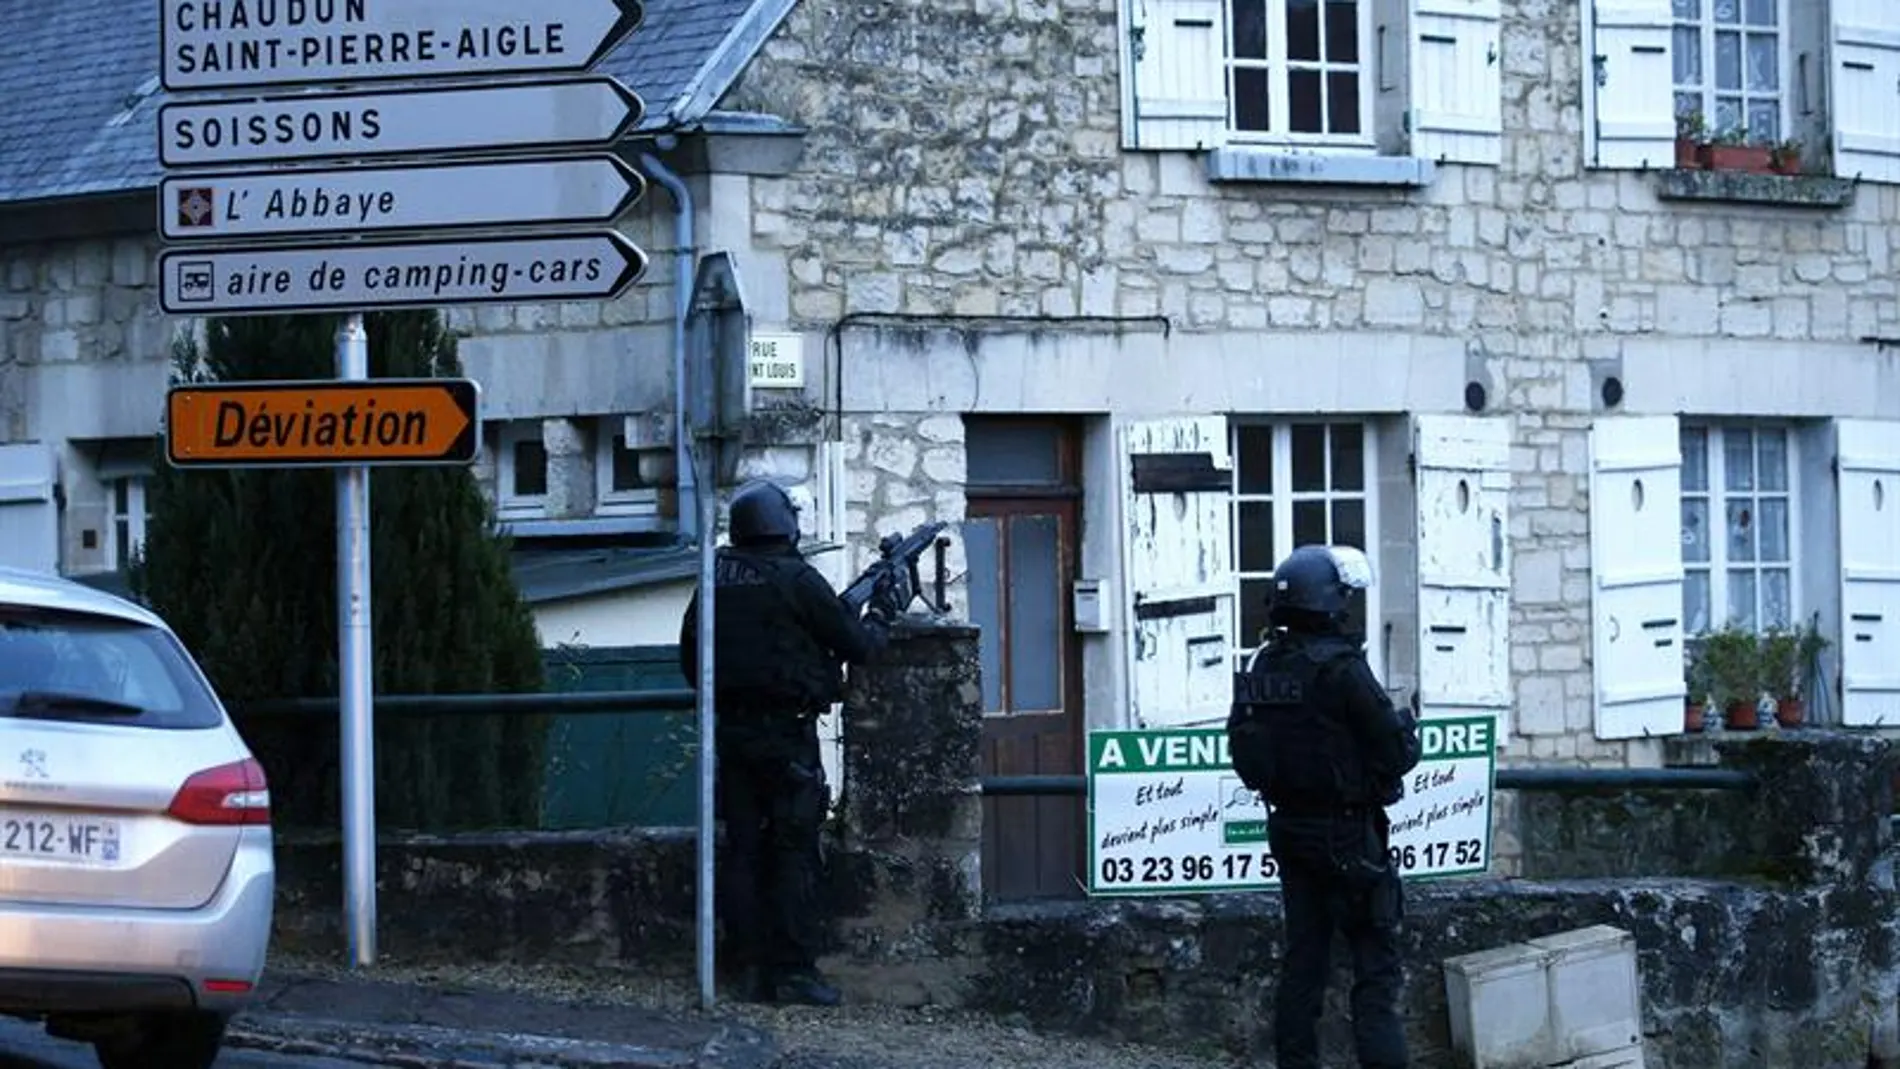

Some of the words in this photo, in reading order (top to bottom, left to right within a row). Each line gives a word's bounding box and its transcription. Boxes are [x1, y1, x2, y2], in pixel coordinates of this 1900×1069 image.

[177, 23, 566, 74] SAINT-PIERRE-AIGLE
[175, 109, 381, 150] SOISSONS
[265, 188, 395, 222] Abbaye
[228, 264, 291, 296] aire
[309, 260, 346, 291] de
[364, 254, 601, 295] camping-cars
[752, 341, 777, 357] RUE
[767, 363, 796, 378] LOUIS
[213, 398, 427, 448] Déviation
[1099, 738, 1126, 768] A
[1136, 735, 1233, 767] VEN
[1421, 723, 1488, 754] DRE
[1135, 785, 1152, 806] Et
[1156, 777, 1183, 800] tout
[1414, 773, 1429, 794] Et
[1432, 765, 1456, 787] tout
[1101, 821, 1147, 850] devient
[1150, 817, 1176, 844] plus
[1180, 804, 1219, 832] simple
[1391, 809, 1423, 834] evient
[1427, 803, 1447, 830] plus
[1451, 790, 1485, 816] simple
[4, 819, 101, 856] 212-WF
[1423, 842, 1449, 867] 17
[1455, 839, 1481, 865] 52
[1102, 858, 1133, 883] 03
[1142, 857, 1173, 882] 23
[1182, 856, 1213, 880] 96
[1223, 854, 1252, 878] 17
[1260, 852, 1278, 877] 5
